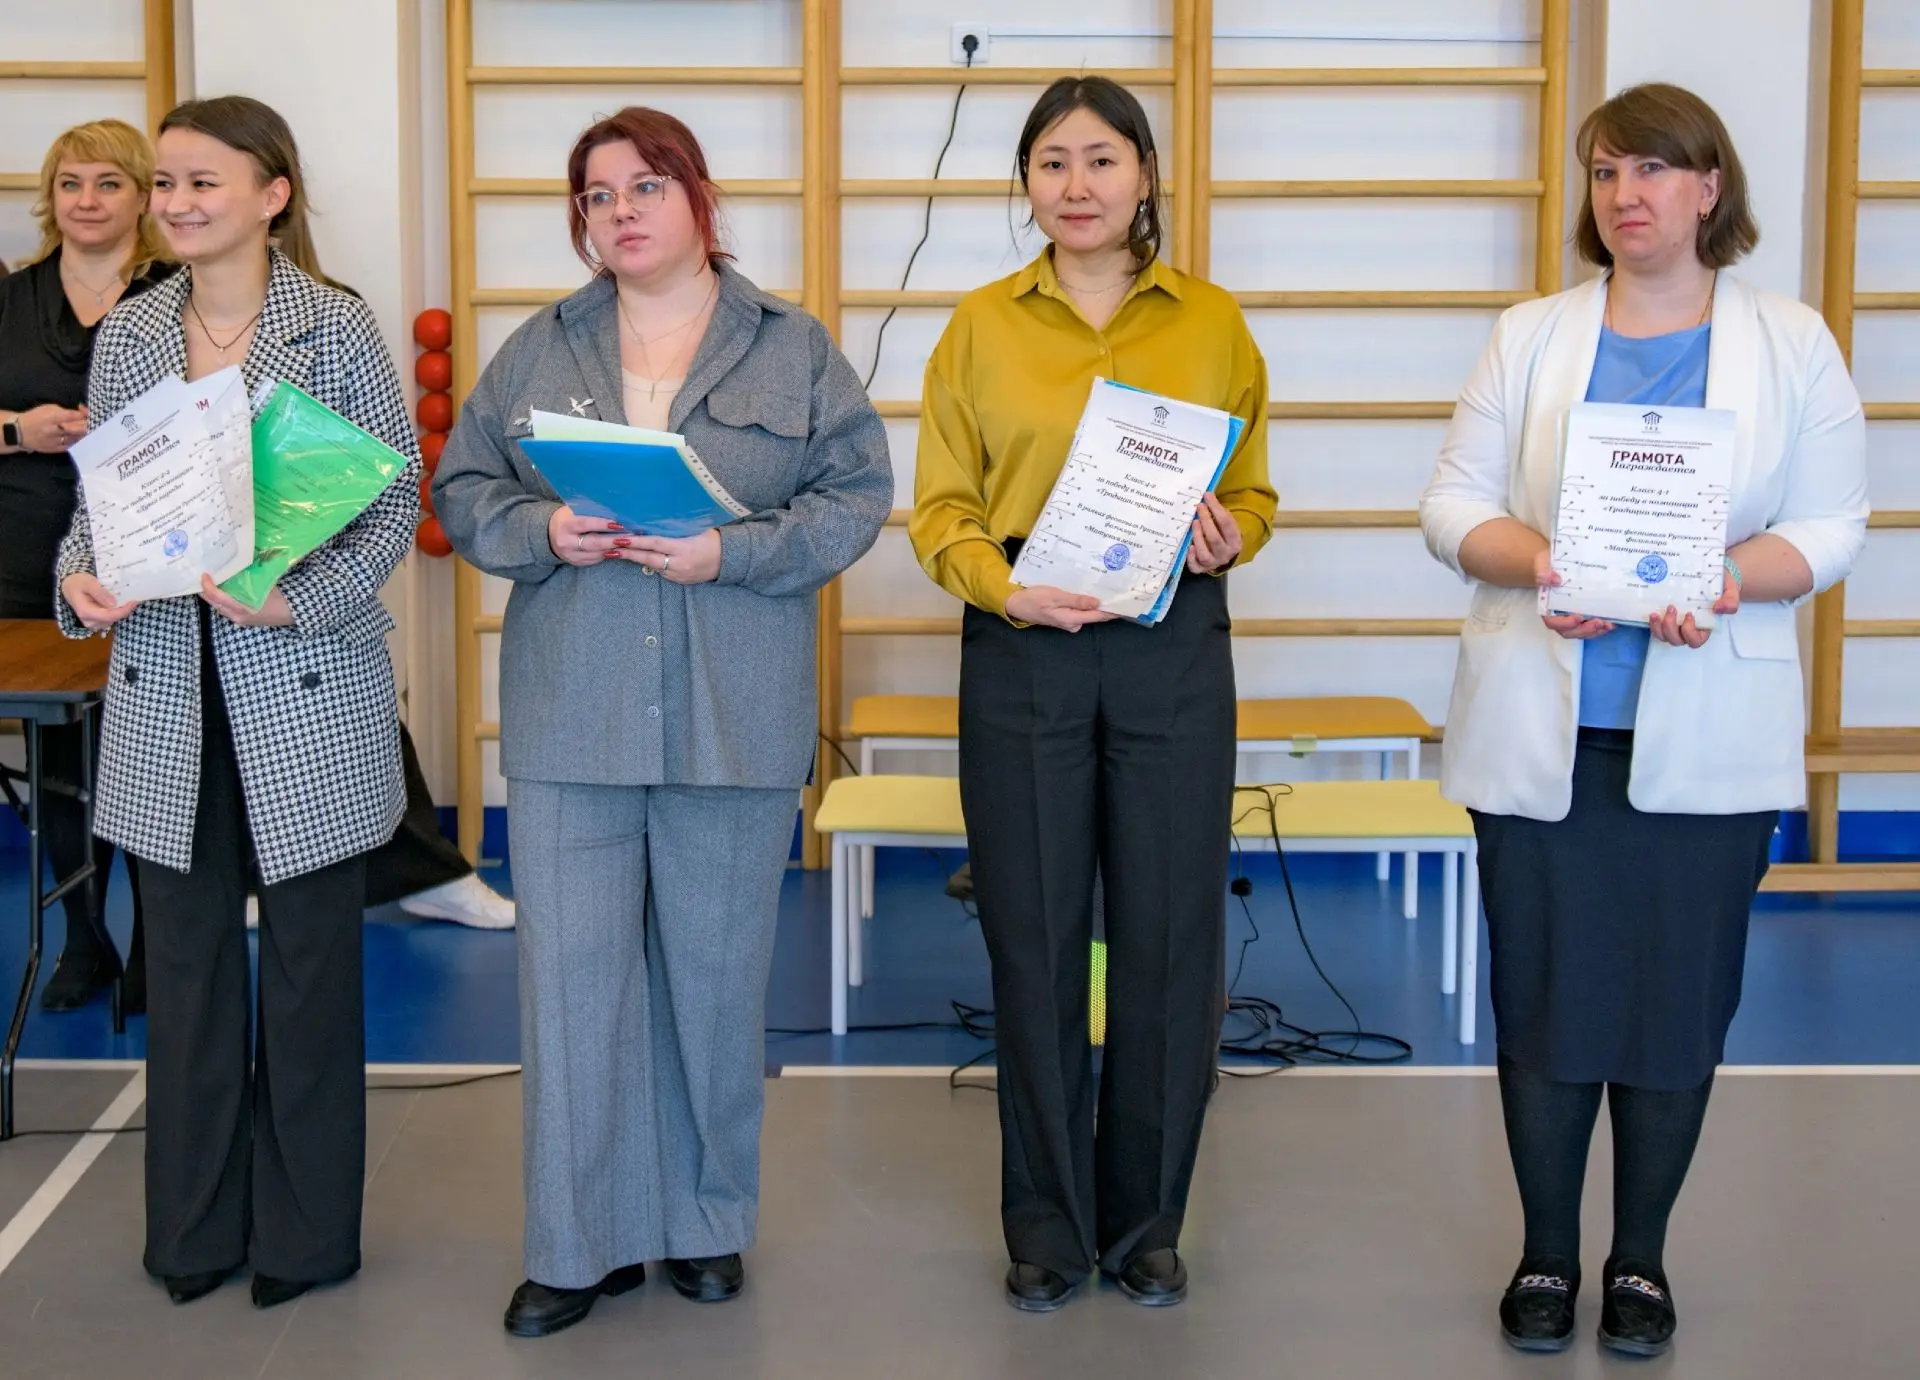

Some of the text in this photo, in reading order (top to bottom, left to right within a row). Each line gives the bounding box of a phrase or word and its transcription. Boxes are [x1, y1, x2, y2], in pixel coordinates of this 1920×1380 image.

[117, 435, 170, 474] ГРАМОТА
[1120, 436, 1178, 463] ГРАМОТА
[120, 440, 180, 481] Награждается
[1116, 445, 1183, 473] Награждается
[1612, 451, 1684, 465] ГРАМОТА
[1610, 460, 1695, 474] Награждается
[1105, 480, 1130, 492] победу
[1630, 486, 1655, 494] Класс
[1610, 496, 1640, 505] победу
[1649, 500, 1698, 508] номинации
